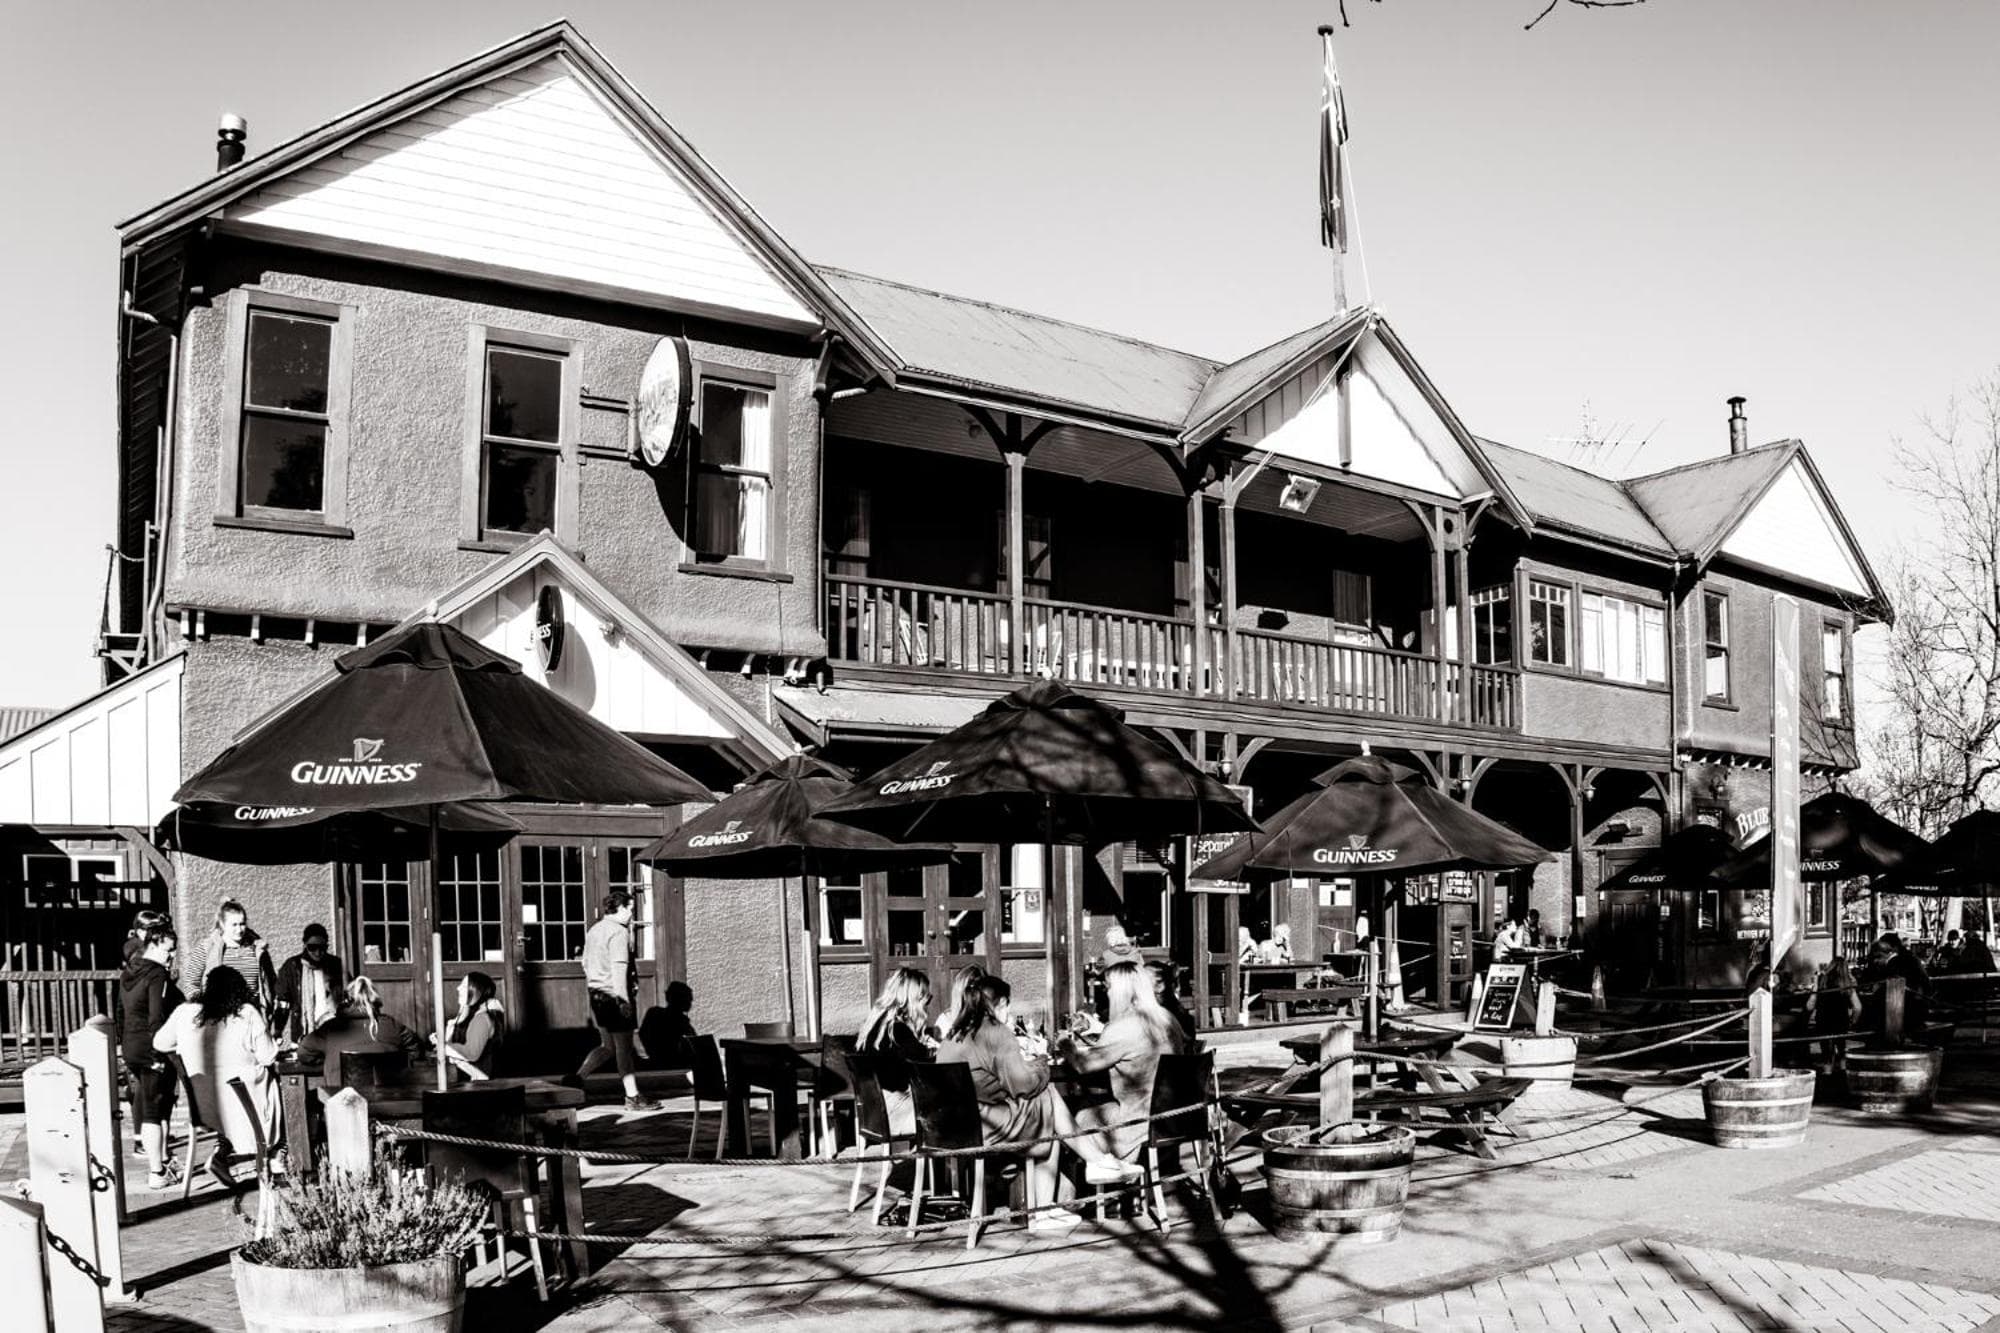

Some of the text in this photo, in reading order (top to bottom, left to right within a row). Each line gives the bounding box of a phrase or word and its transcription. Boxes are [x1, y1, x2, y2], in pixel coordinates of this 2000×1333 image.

[290, 761, 419, 785] GUINNESS
[879, 775, 953, 795] GUINNESS
[687, 831, 752, 848] GUINNESS
[1312, 848, 1397, 865] GUINNESS
[1800, 860, 1841, 871] INNESS
